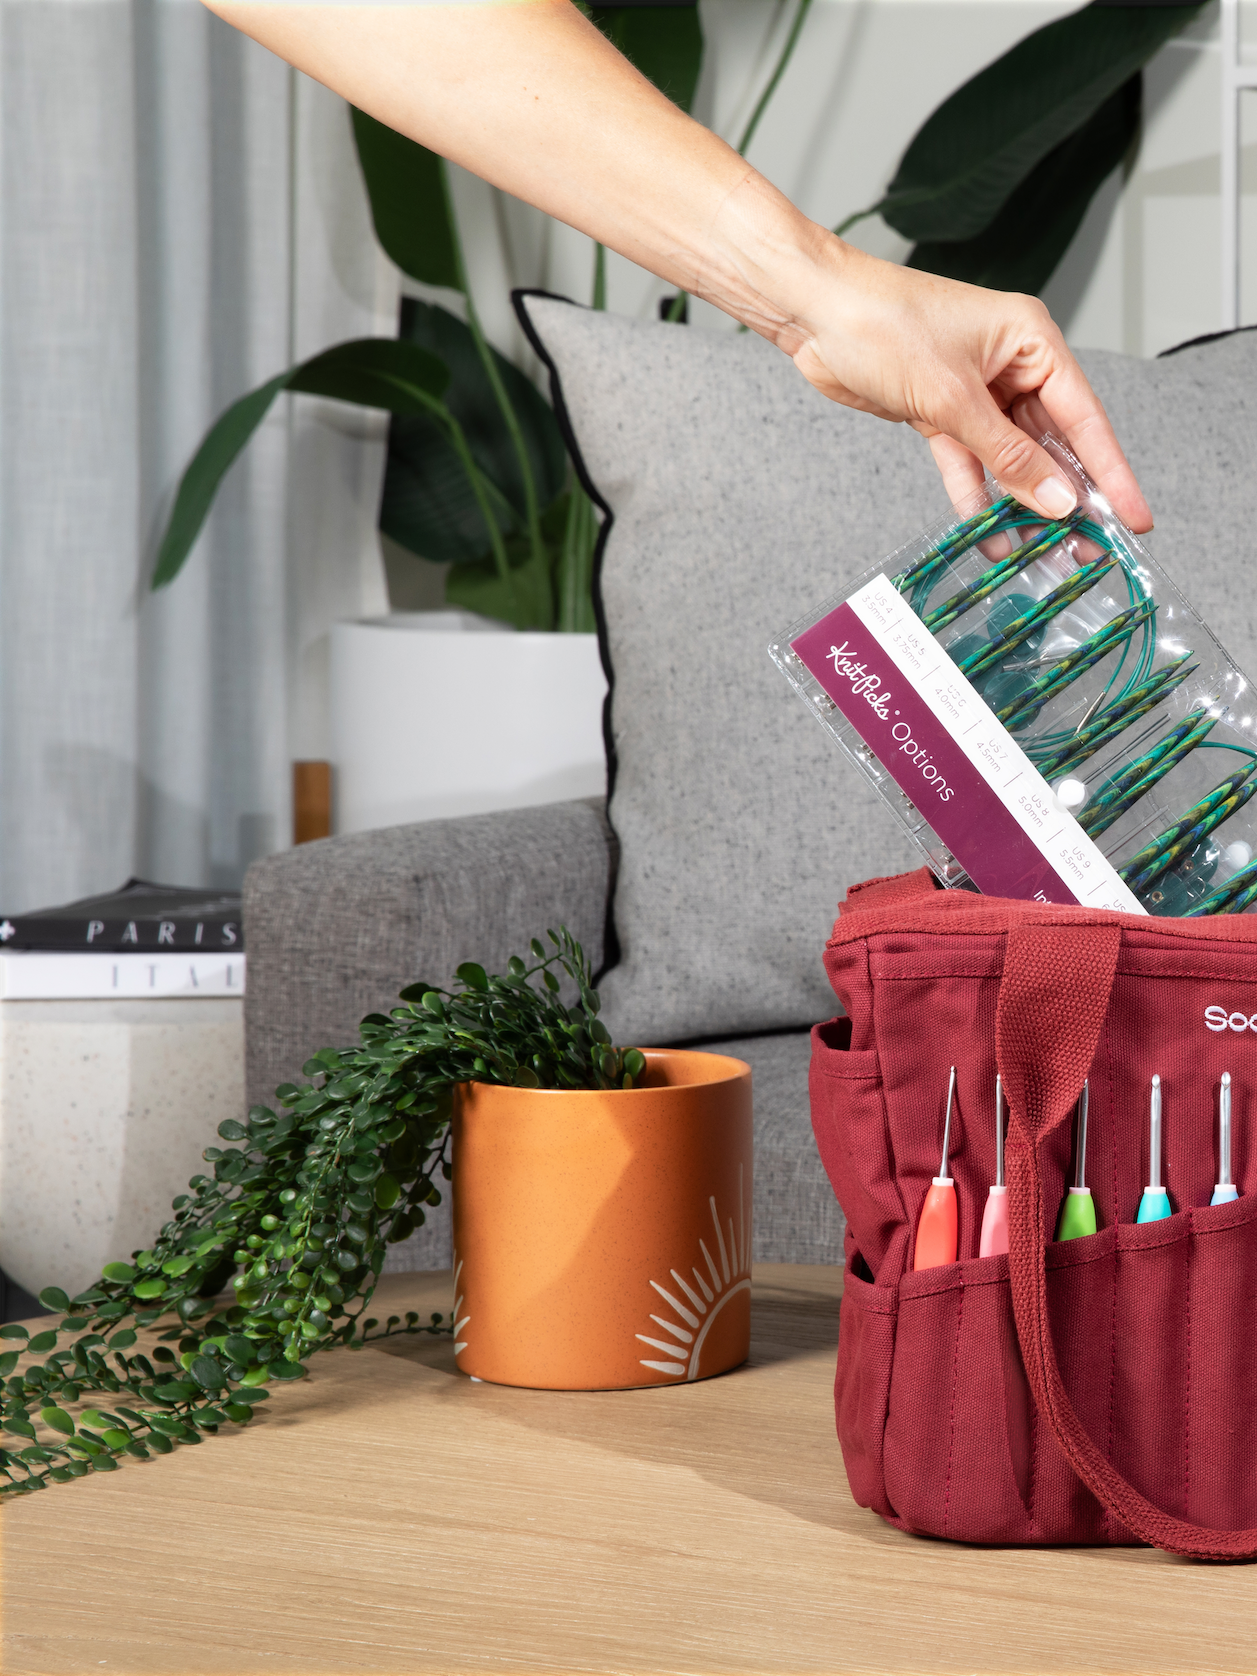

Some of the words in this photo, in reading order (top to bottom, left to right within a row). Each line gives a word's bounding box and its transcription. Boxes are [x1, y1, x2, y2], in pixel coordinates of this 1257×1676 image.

[861, 594, 887, 626] 3.5mm
[892, 634, 922, 670] 3.75mm
[935, 687, 960, 719] 4.0mm
[891, 722, 955, 802] Options
[976, 742, 1001, 773] 4.5mm
[1018, 796, 1044, 828] 5.0mm
[1059, 849, 1085, 881] 5.5mm
[86, 920, 238, 945] PARIS
